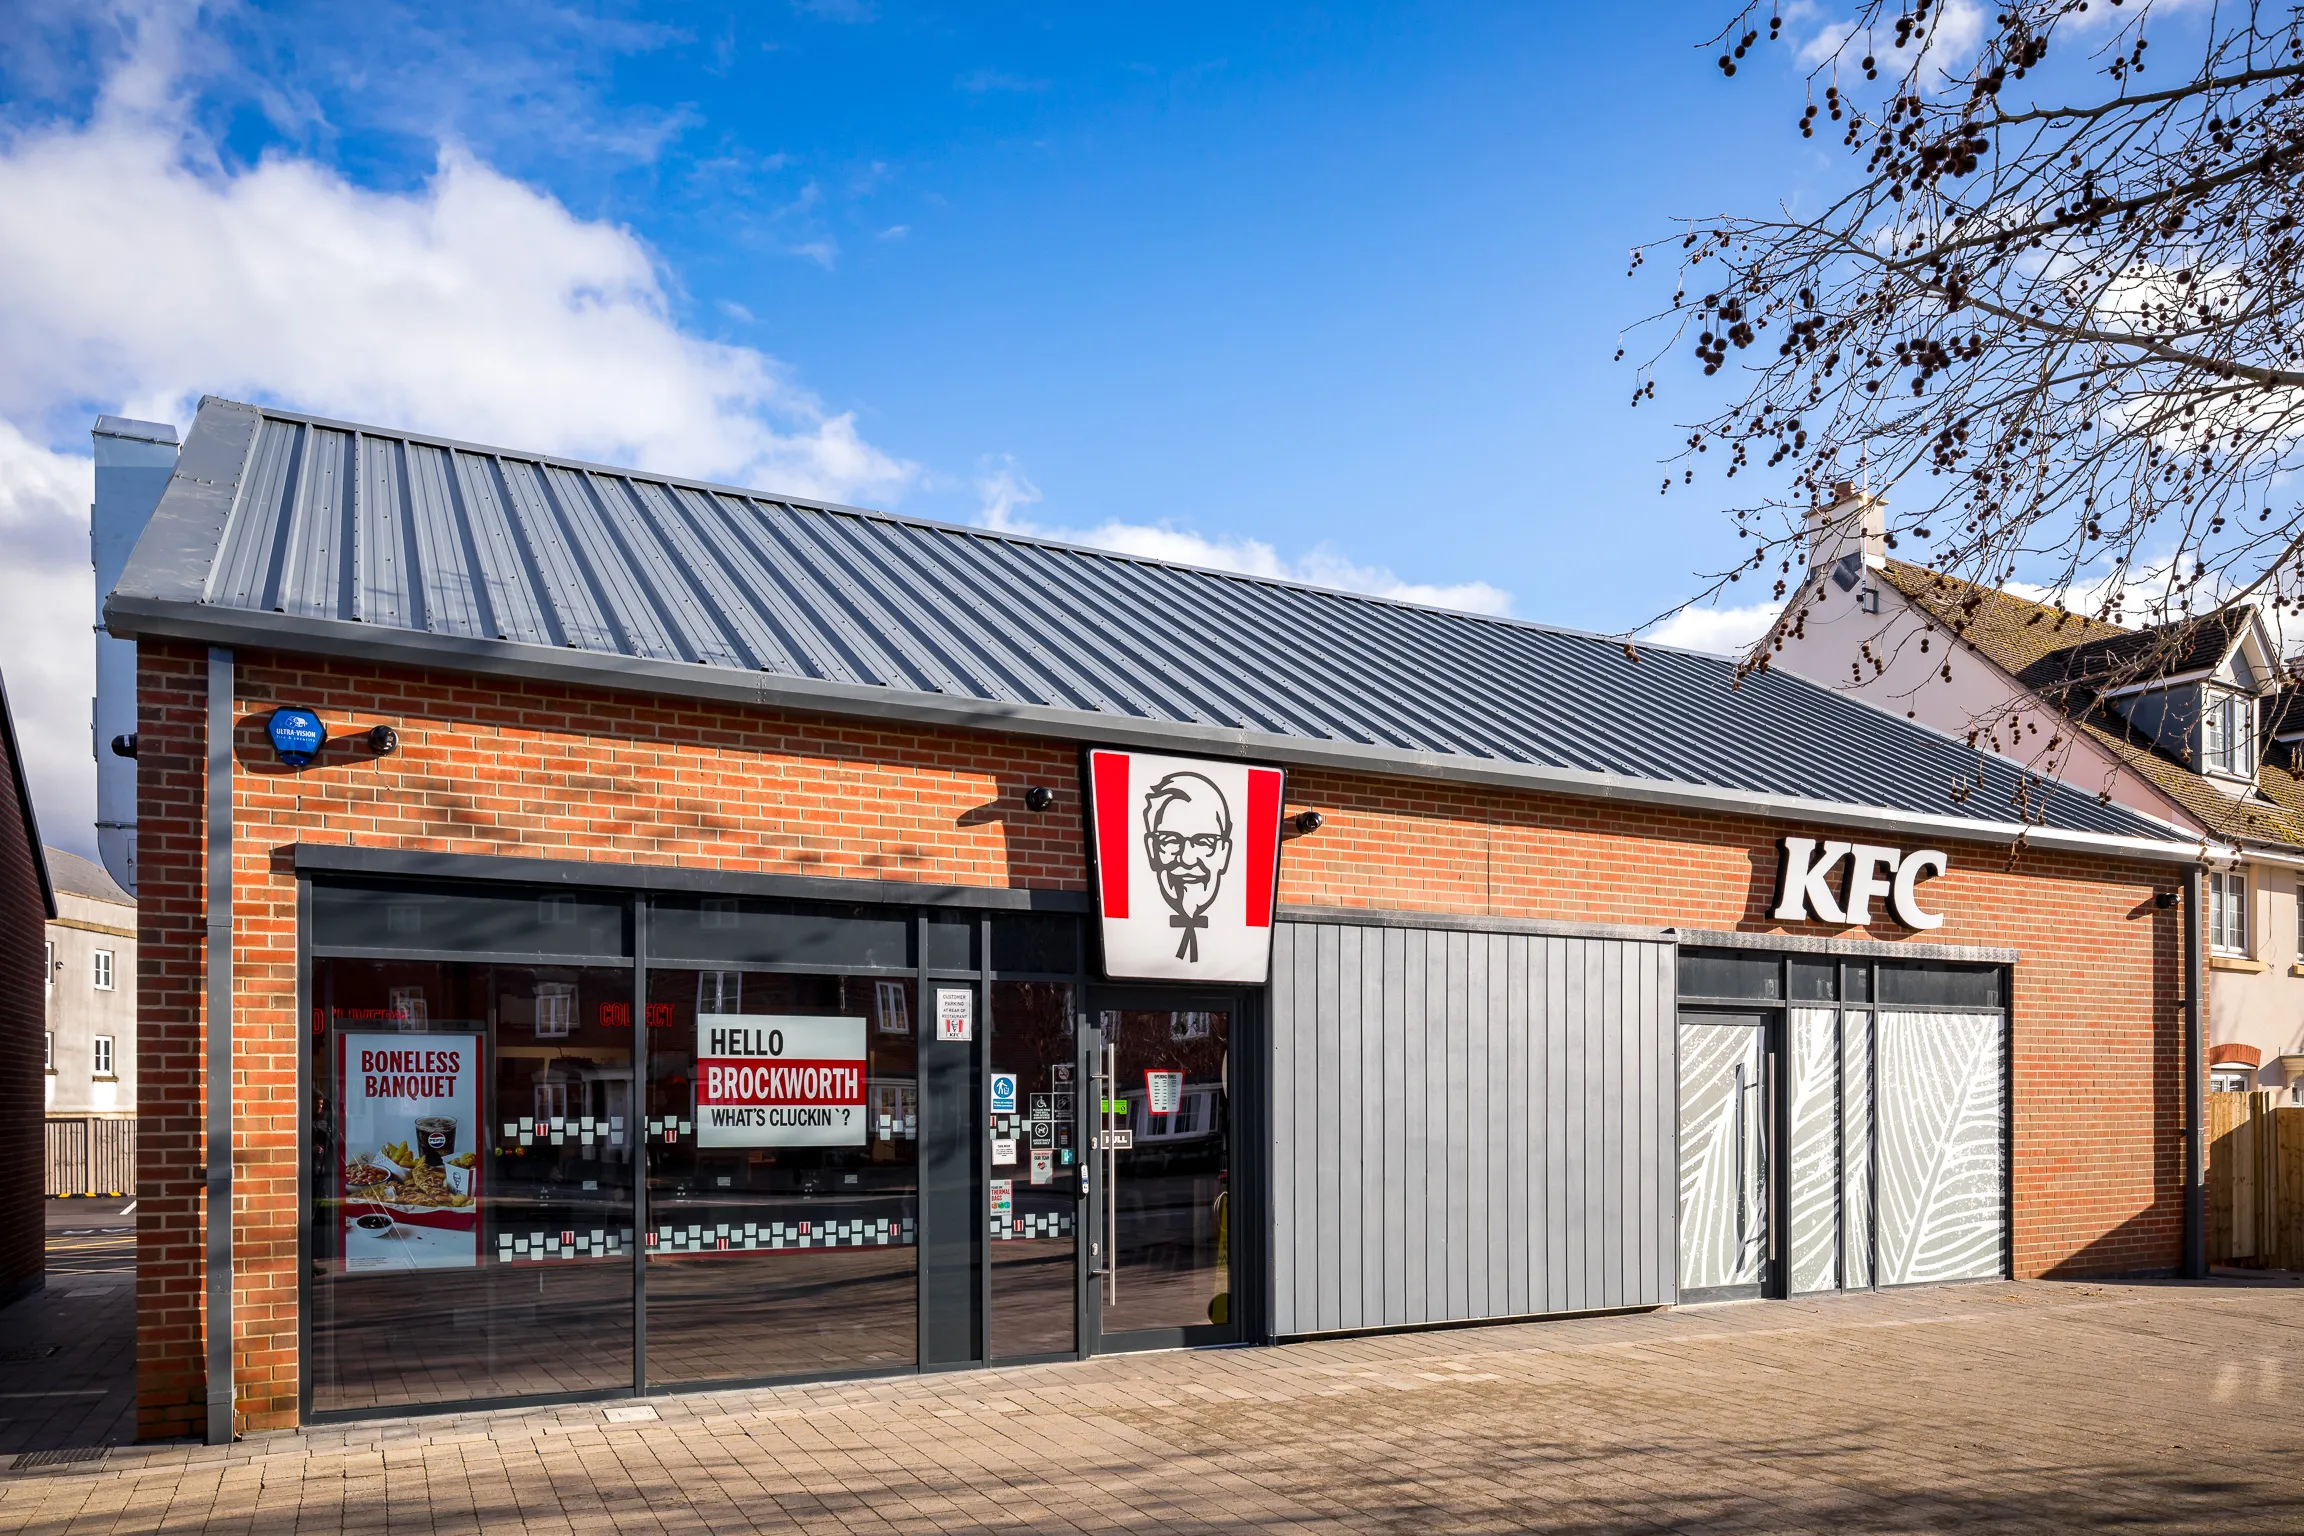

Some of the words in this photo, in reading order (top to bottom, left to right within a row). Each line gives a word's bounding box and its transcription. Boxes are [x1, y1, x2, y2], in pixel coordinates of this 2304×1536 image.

[276, 728, 316, 738] ULTRA-VISION
[1772, 836, 1948, 930] KFC
[599, 1002, 675, 1027] COLECT
[710, 1028, 784, 1057] HELLO
[361, 1050, 460, 1073] BONELESS
[365, 1075, 457, 1101] BANQUET
[708, 1066, 858, 1099] BROCKWORTH
[711, 1108, 766, 1127] WHAT'S
[769, 1108, 832, 1127] CLUCKIN
